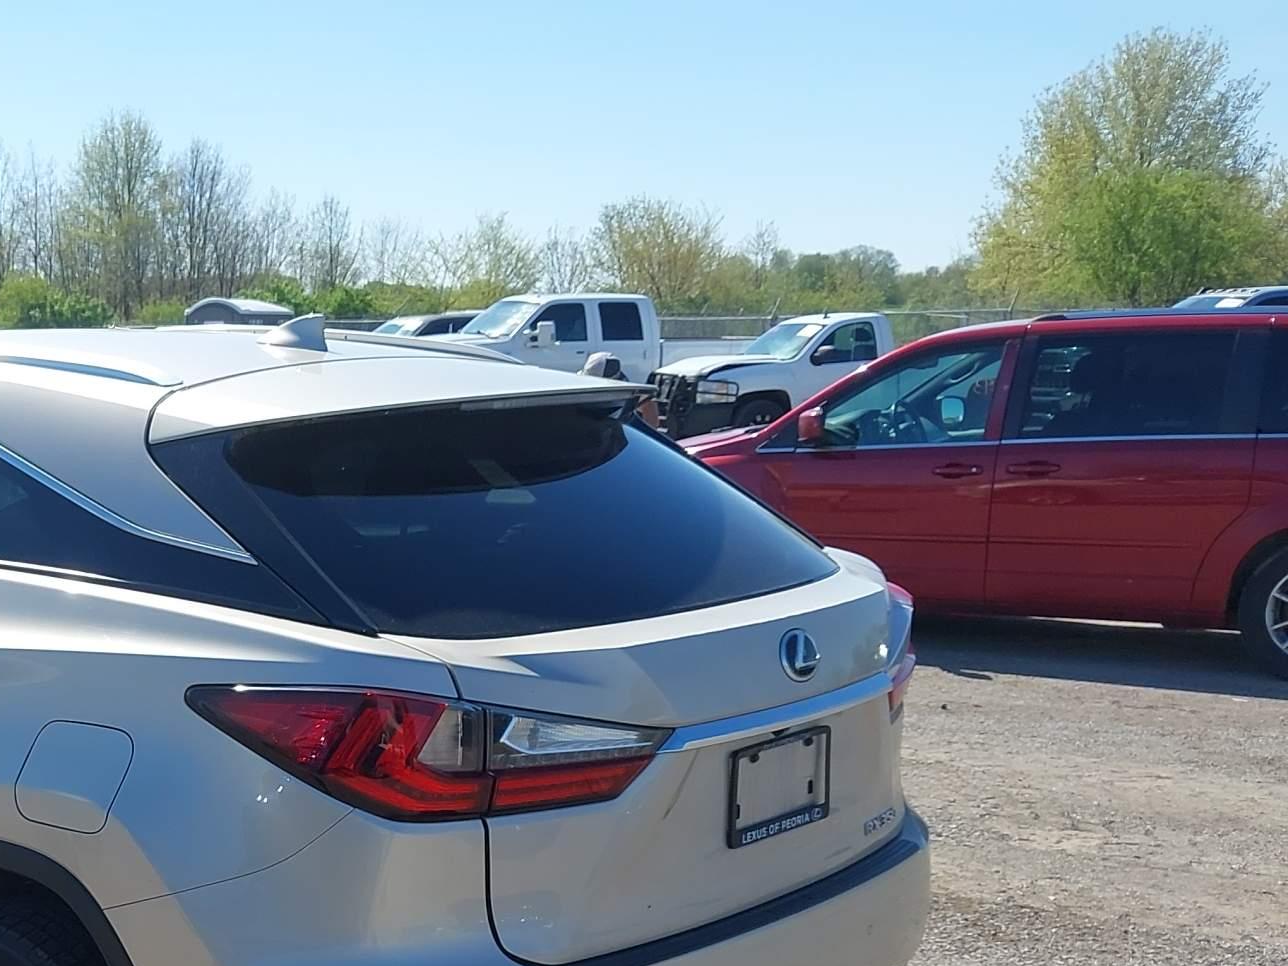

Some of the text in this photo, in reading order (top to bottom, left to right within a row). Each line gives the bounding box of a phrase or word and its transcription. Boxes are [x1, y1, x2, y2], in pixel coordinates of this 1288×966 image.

[742, 812, 810, 844] LEXUS OF PEORIA
